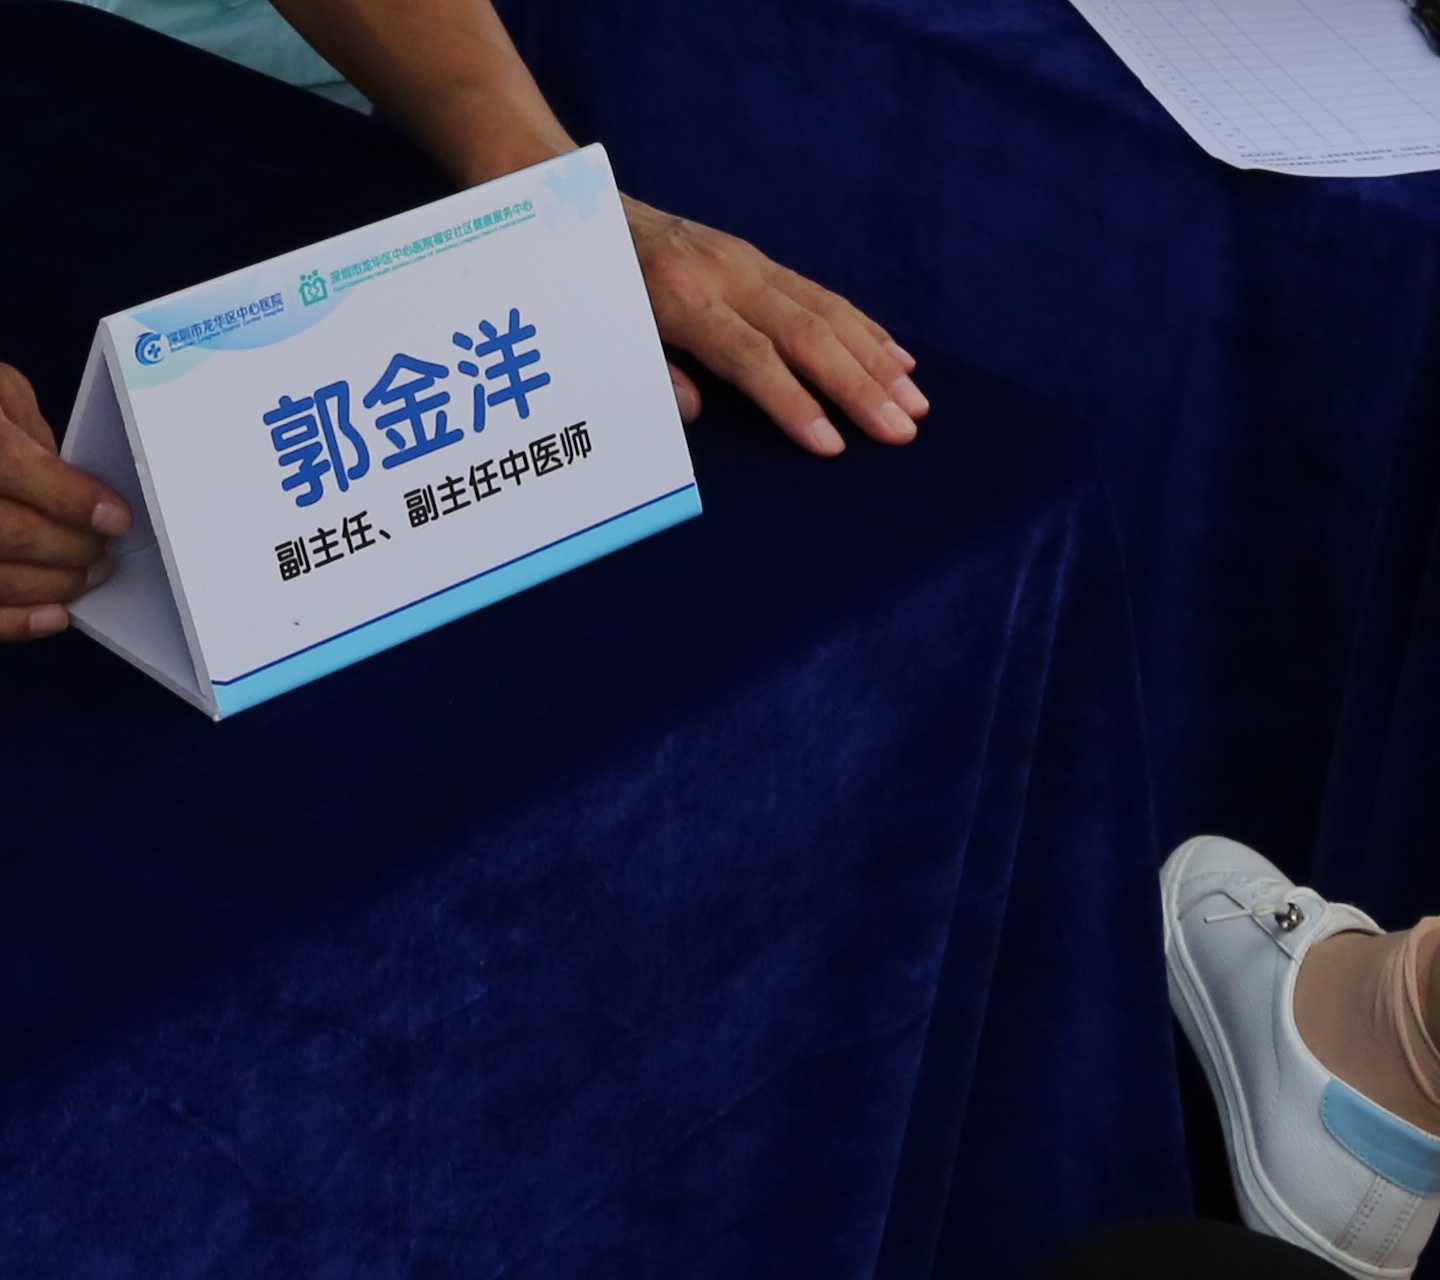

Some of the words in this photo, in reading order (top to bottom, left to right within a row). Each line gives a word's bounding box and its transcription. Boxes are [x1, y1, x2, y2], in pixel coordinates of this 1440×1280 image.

[167, 292, 284, 346] 深圳市龙华区中心医院
[261, 307, 552, 509] 郭金洋
[274, 420, 593, 582] 副主任、副主任中医师
